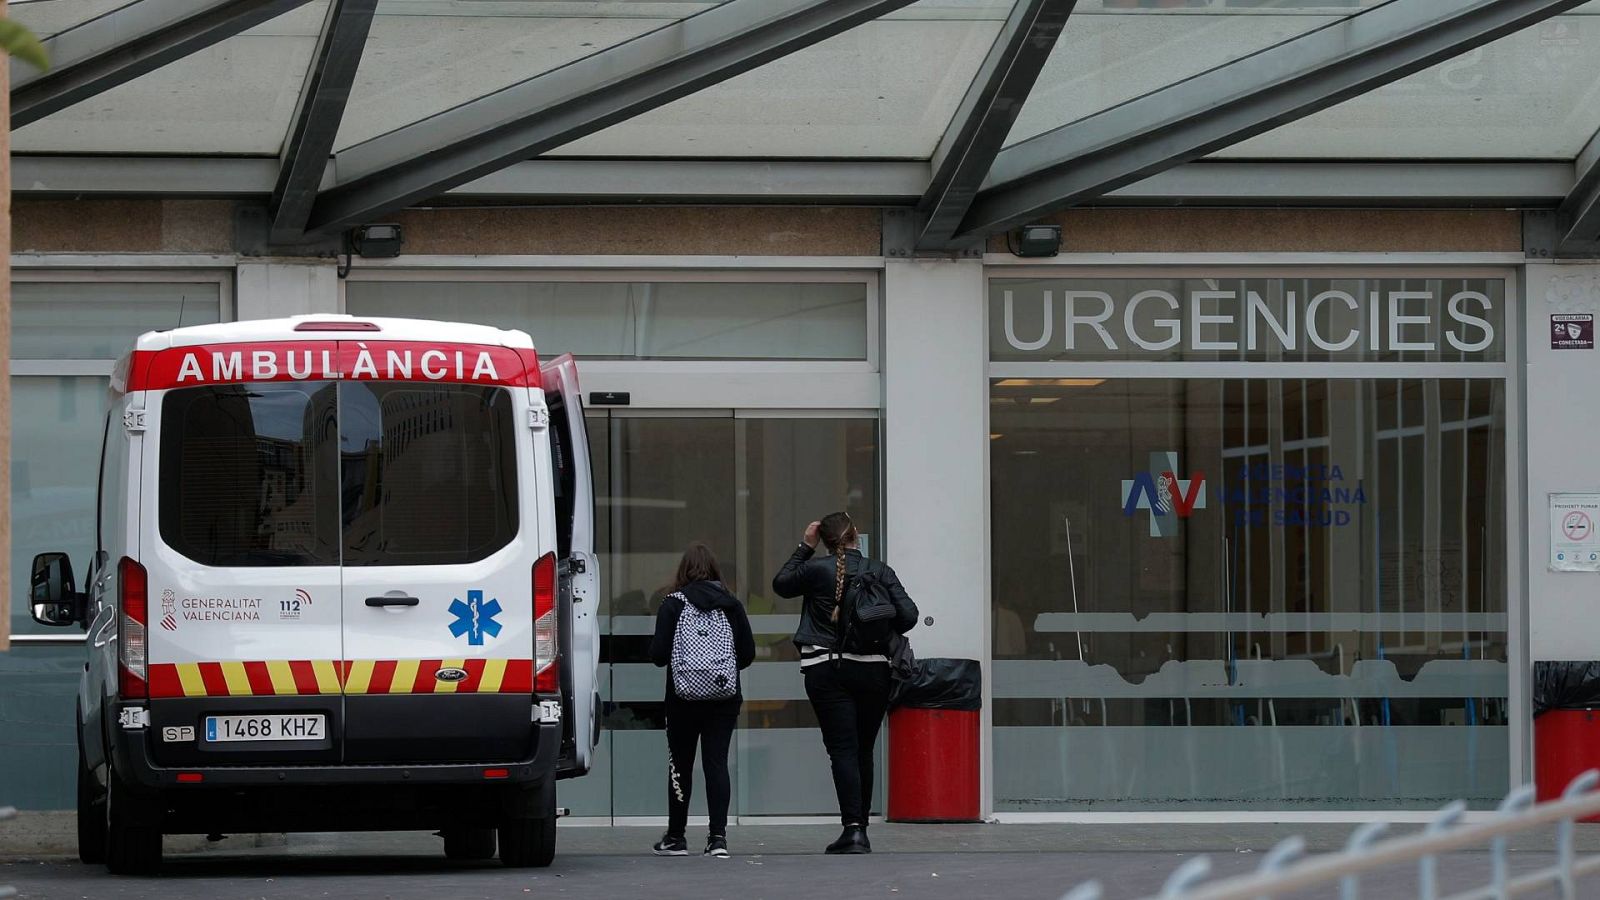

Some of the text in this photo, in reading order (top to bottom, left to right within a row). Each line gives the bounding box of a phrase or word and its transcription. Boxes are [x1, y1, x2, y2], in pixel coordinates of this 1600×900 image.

[1003, 278, 1495, 352] URGÈNCIES
[1554, 323, 1565, 331] 24
[177, 342, 499, 382] AMBULÀNCIA
[1273, 509, 1350, 527] SALUD
[181, 598, 262, 609] GENERALITAT
[279, 600, 300, 611] 112
[182, 610, 260, 621] VALENCIANA
[165, 727, 192, 741] SP
[224, 717, 319, 738] 1468 KHZ
